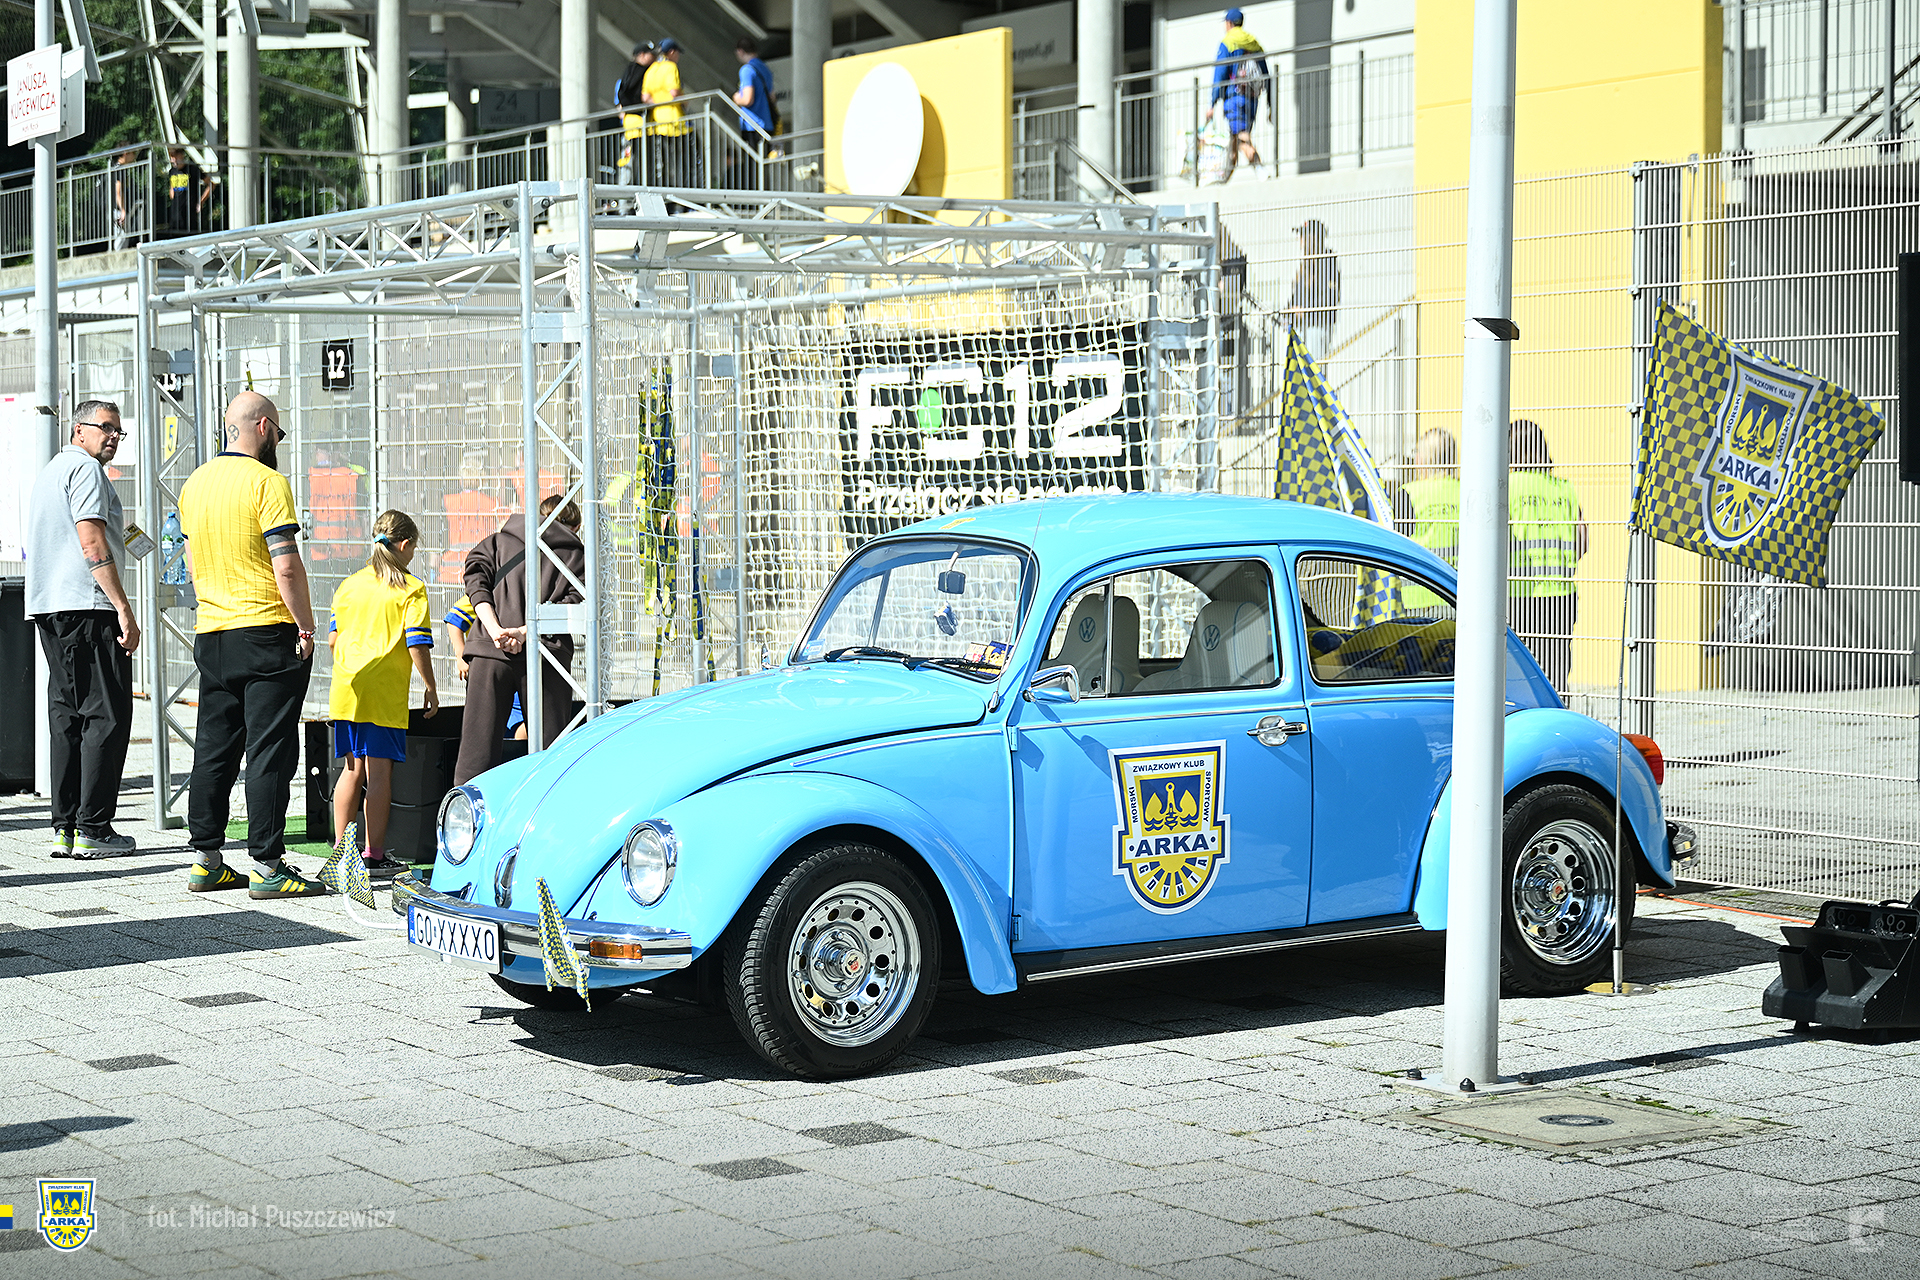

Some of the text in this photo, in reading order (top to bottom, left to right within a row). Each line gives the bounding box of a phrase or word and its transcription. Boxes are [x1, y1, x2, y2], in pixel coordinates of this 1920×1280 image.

[16, 71, 48, 96] JANUSZA
[495, 90, 518, 112] 24
[10, 91, 57, 120] KUPCEWICZA
[327, 349, 346, 380] 12
[857, 353, 1123, 461] FC12
[1725, 393, 1743, 434] MORSKI
[1775, 405, 1796, 461] SPORTOWY
[1720, 455, 1772, 491] ARKA
[1132, 759, 1206, 773] ZWIĄZKOWY KLUB
[1128, 786, 1139, 824] MORSKI
[1203, 770, 1213, 823] SPORTOWY
[1135, 833, 1210, 858] ARKA
[1138, 859, 1209, 899] GDYNIA
